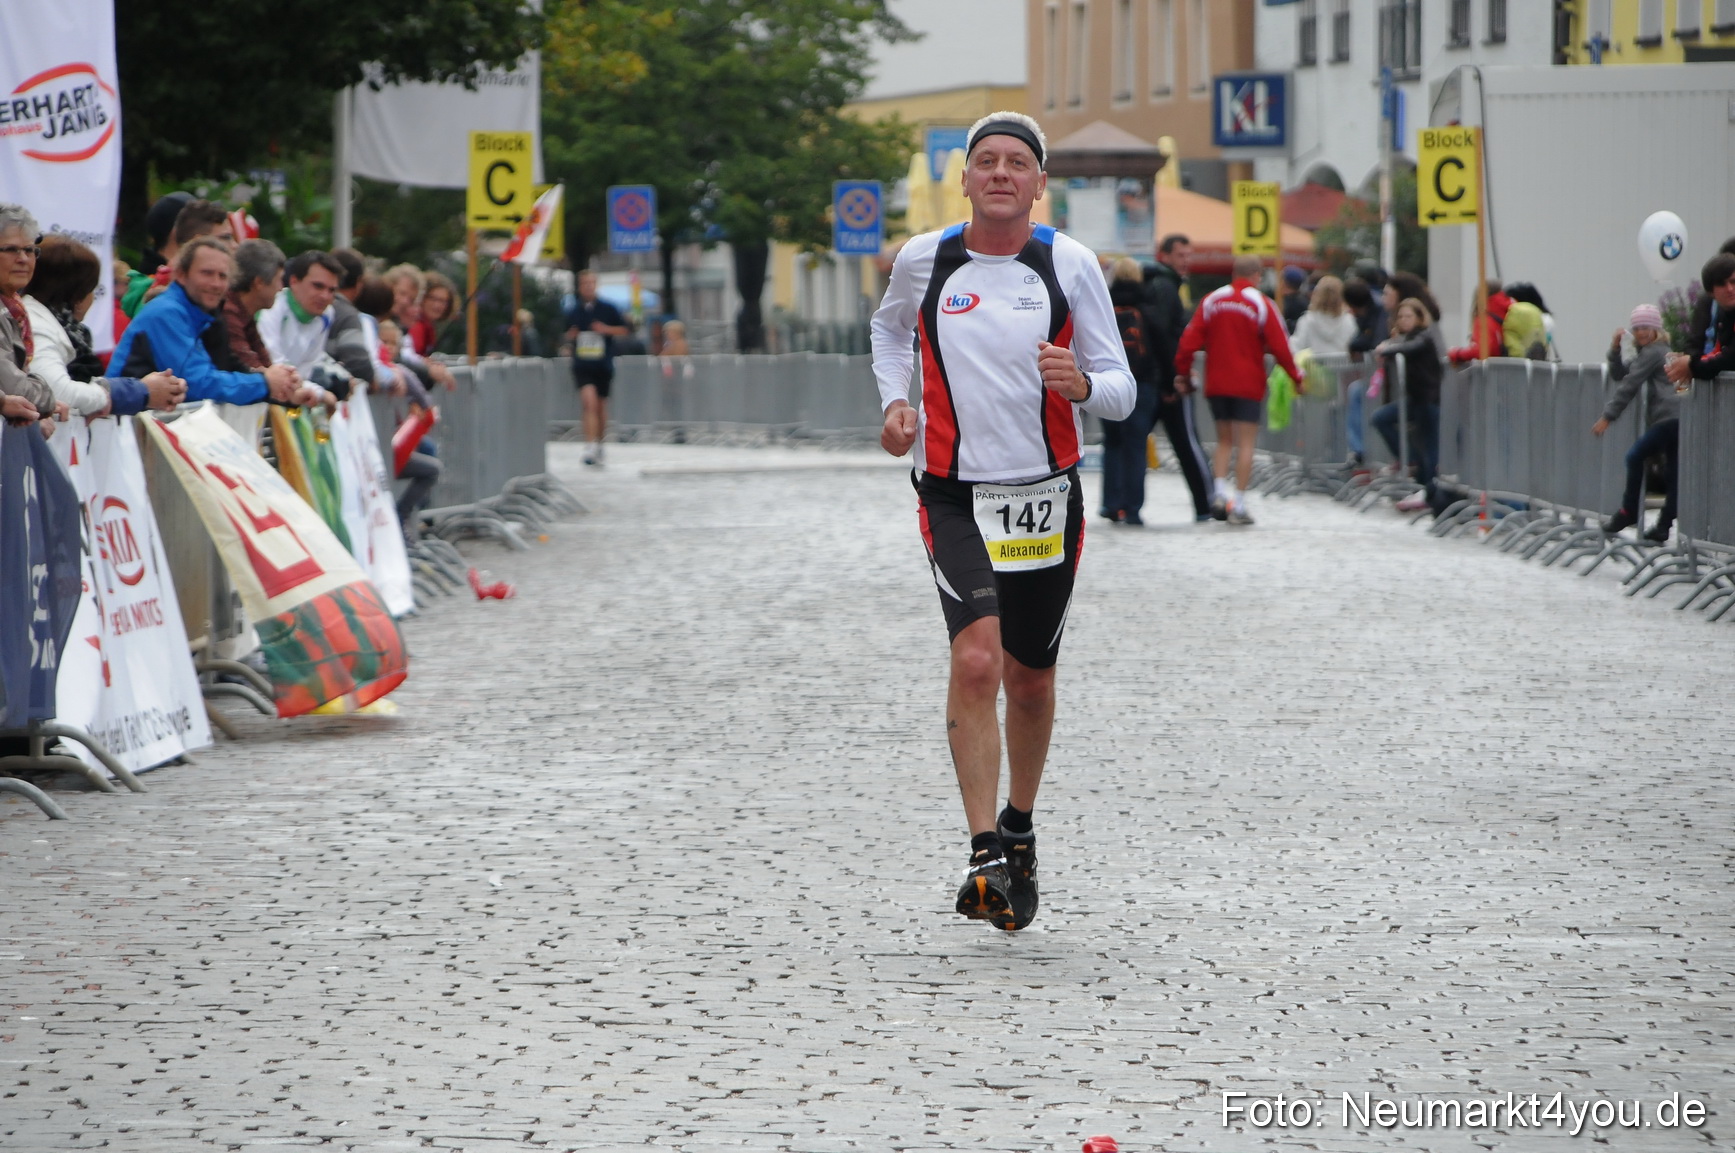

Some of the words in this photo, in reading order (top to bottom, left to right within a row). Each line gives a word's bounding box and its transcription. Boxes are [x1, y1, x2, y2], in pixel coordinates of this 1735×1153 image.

[475, 133, 525, 151] Block
[1423, 130, 1474, 148] Block
[485, 160, 516, 206] C
[1433, 156, 1465, 202] C
[1238, 183, 1276, 198] Block
[1246, 204, 1270, 238] D
[946, 294, 970, 307] tkn
[996, 499, 1052, 534] 142
[1000, 543, 1053, 558] Alexander
